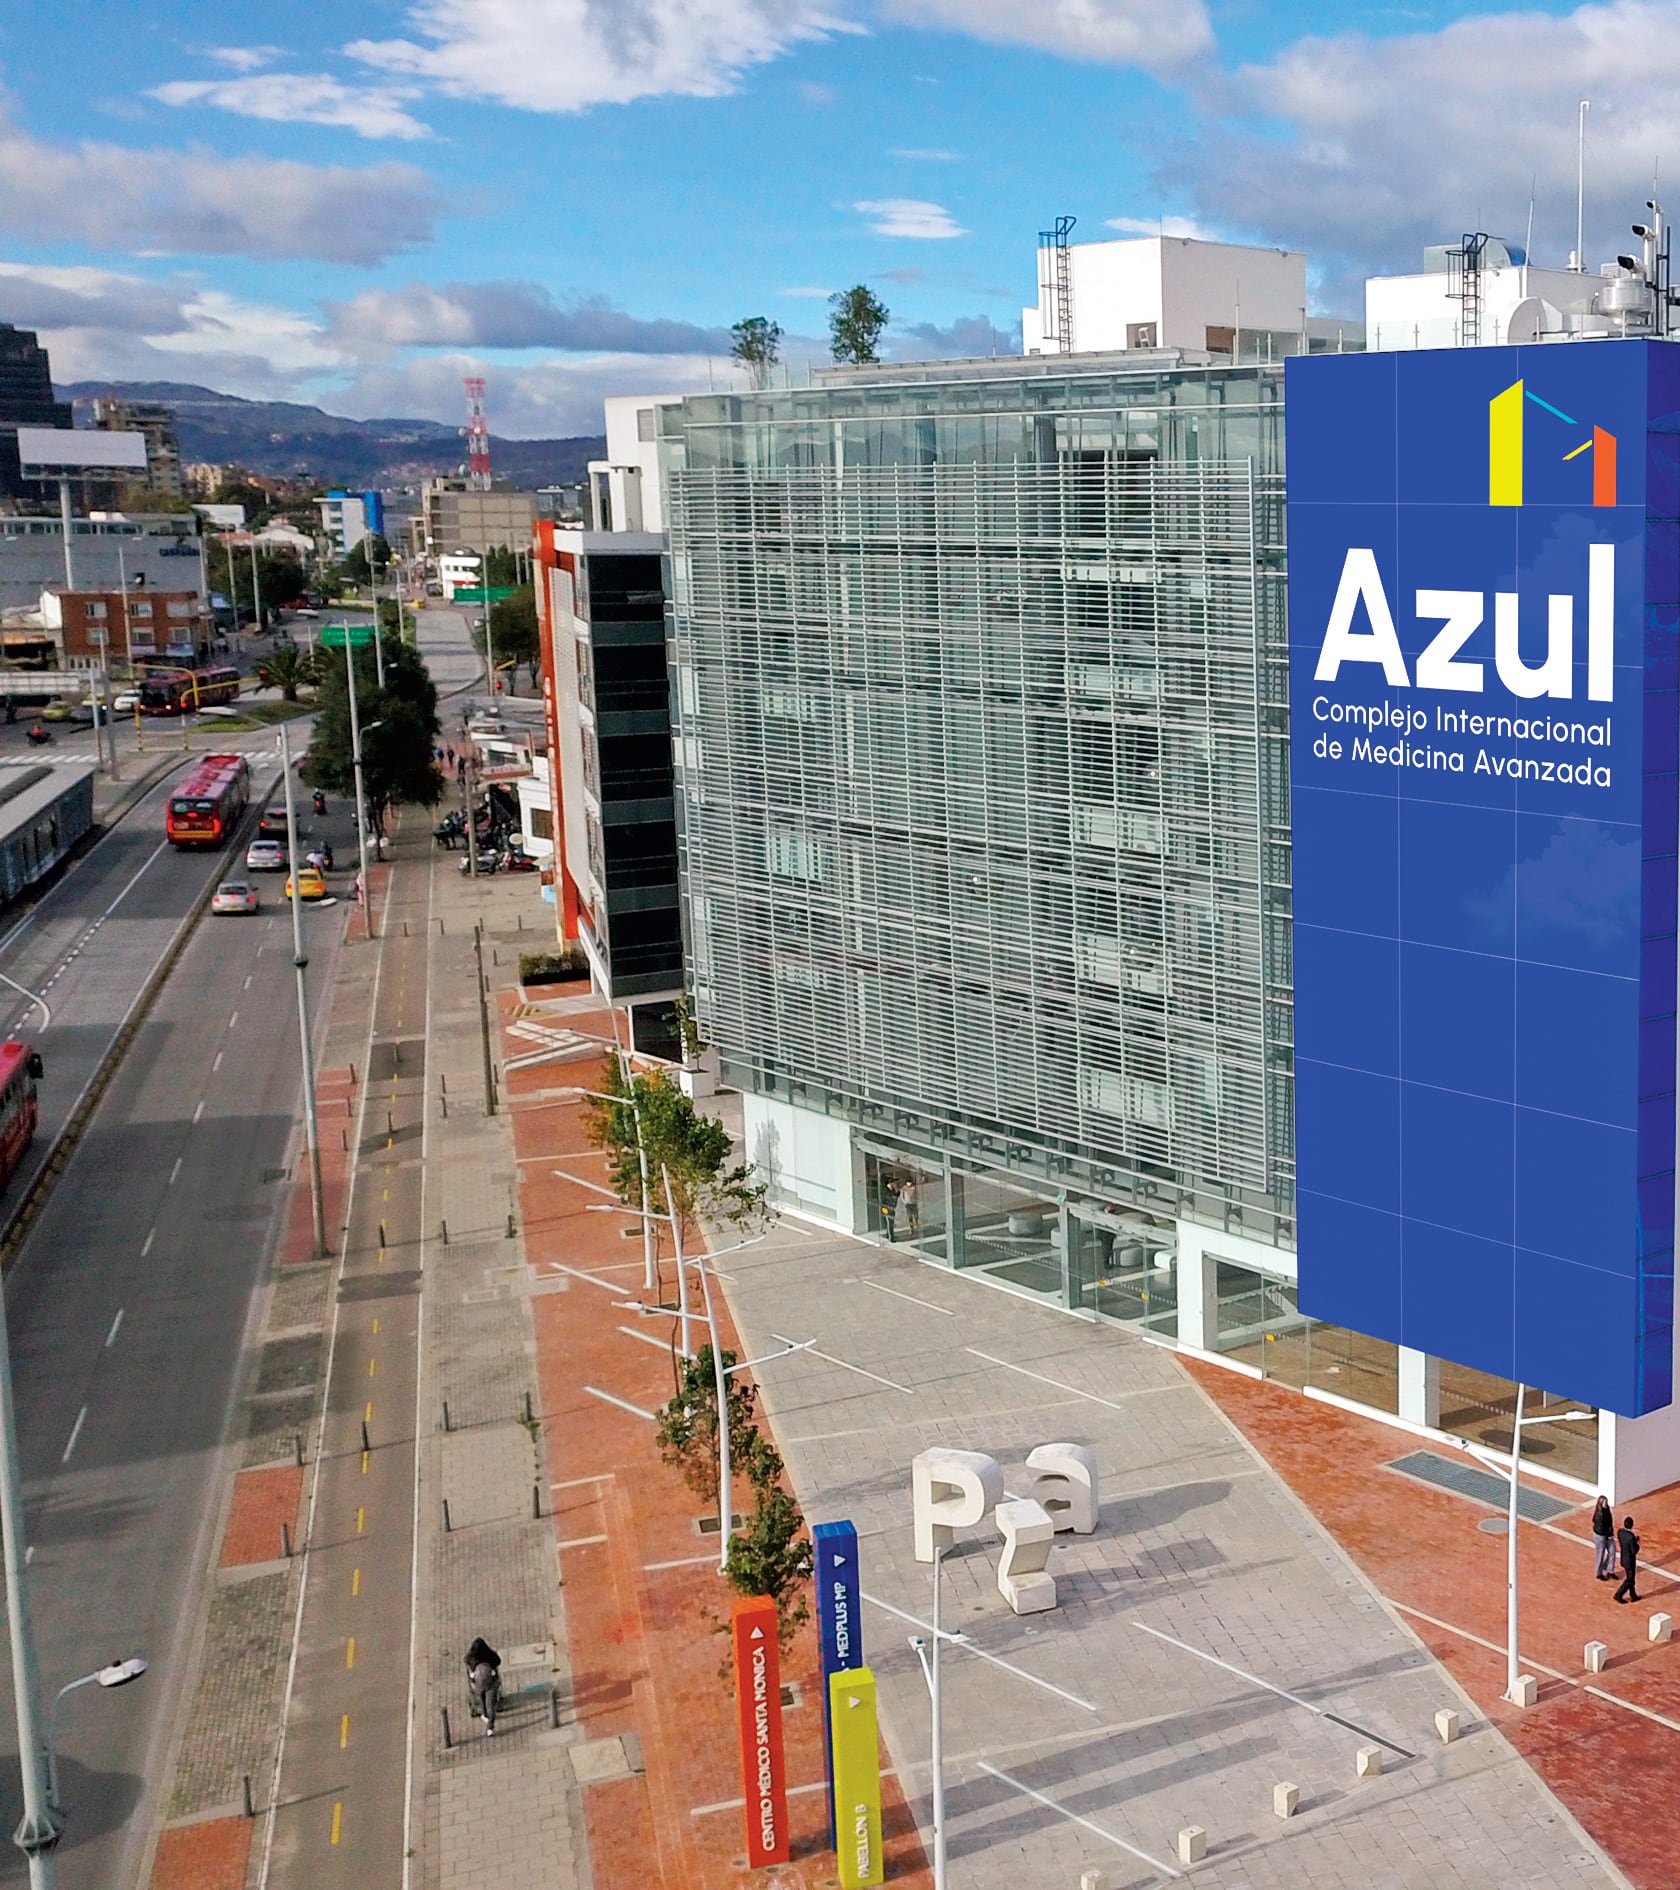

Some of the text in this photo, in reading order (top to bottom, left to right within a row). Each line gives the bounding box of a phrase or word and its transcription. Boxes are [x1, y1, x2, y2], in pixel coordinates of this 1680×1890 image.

[1313, 543, 1615, 703] Azul
[1312, 696, 1611, 746] Complejo Internacional
[1313, 732, 1611, 788] de Medicina Avanzada
[834, 1581, 847, 1601] MP
[834, 1601, 850, 1659] MEDPLUS
[755, 1701, 769, 1745] SANTA
[757, 1746, 772, 1797] MÉDICO
[760, 1798, 776, 1852] CENTRO
[855, 1803, 867, 1814] B
